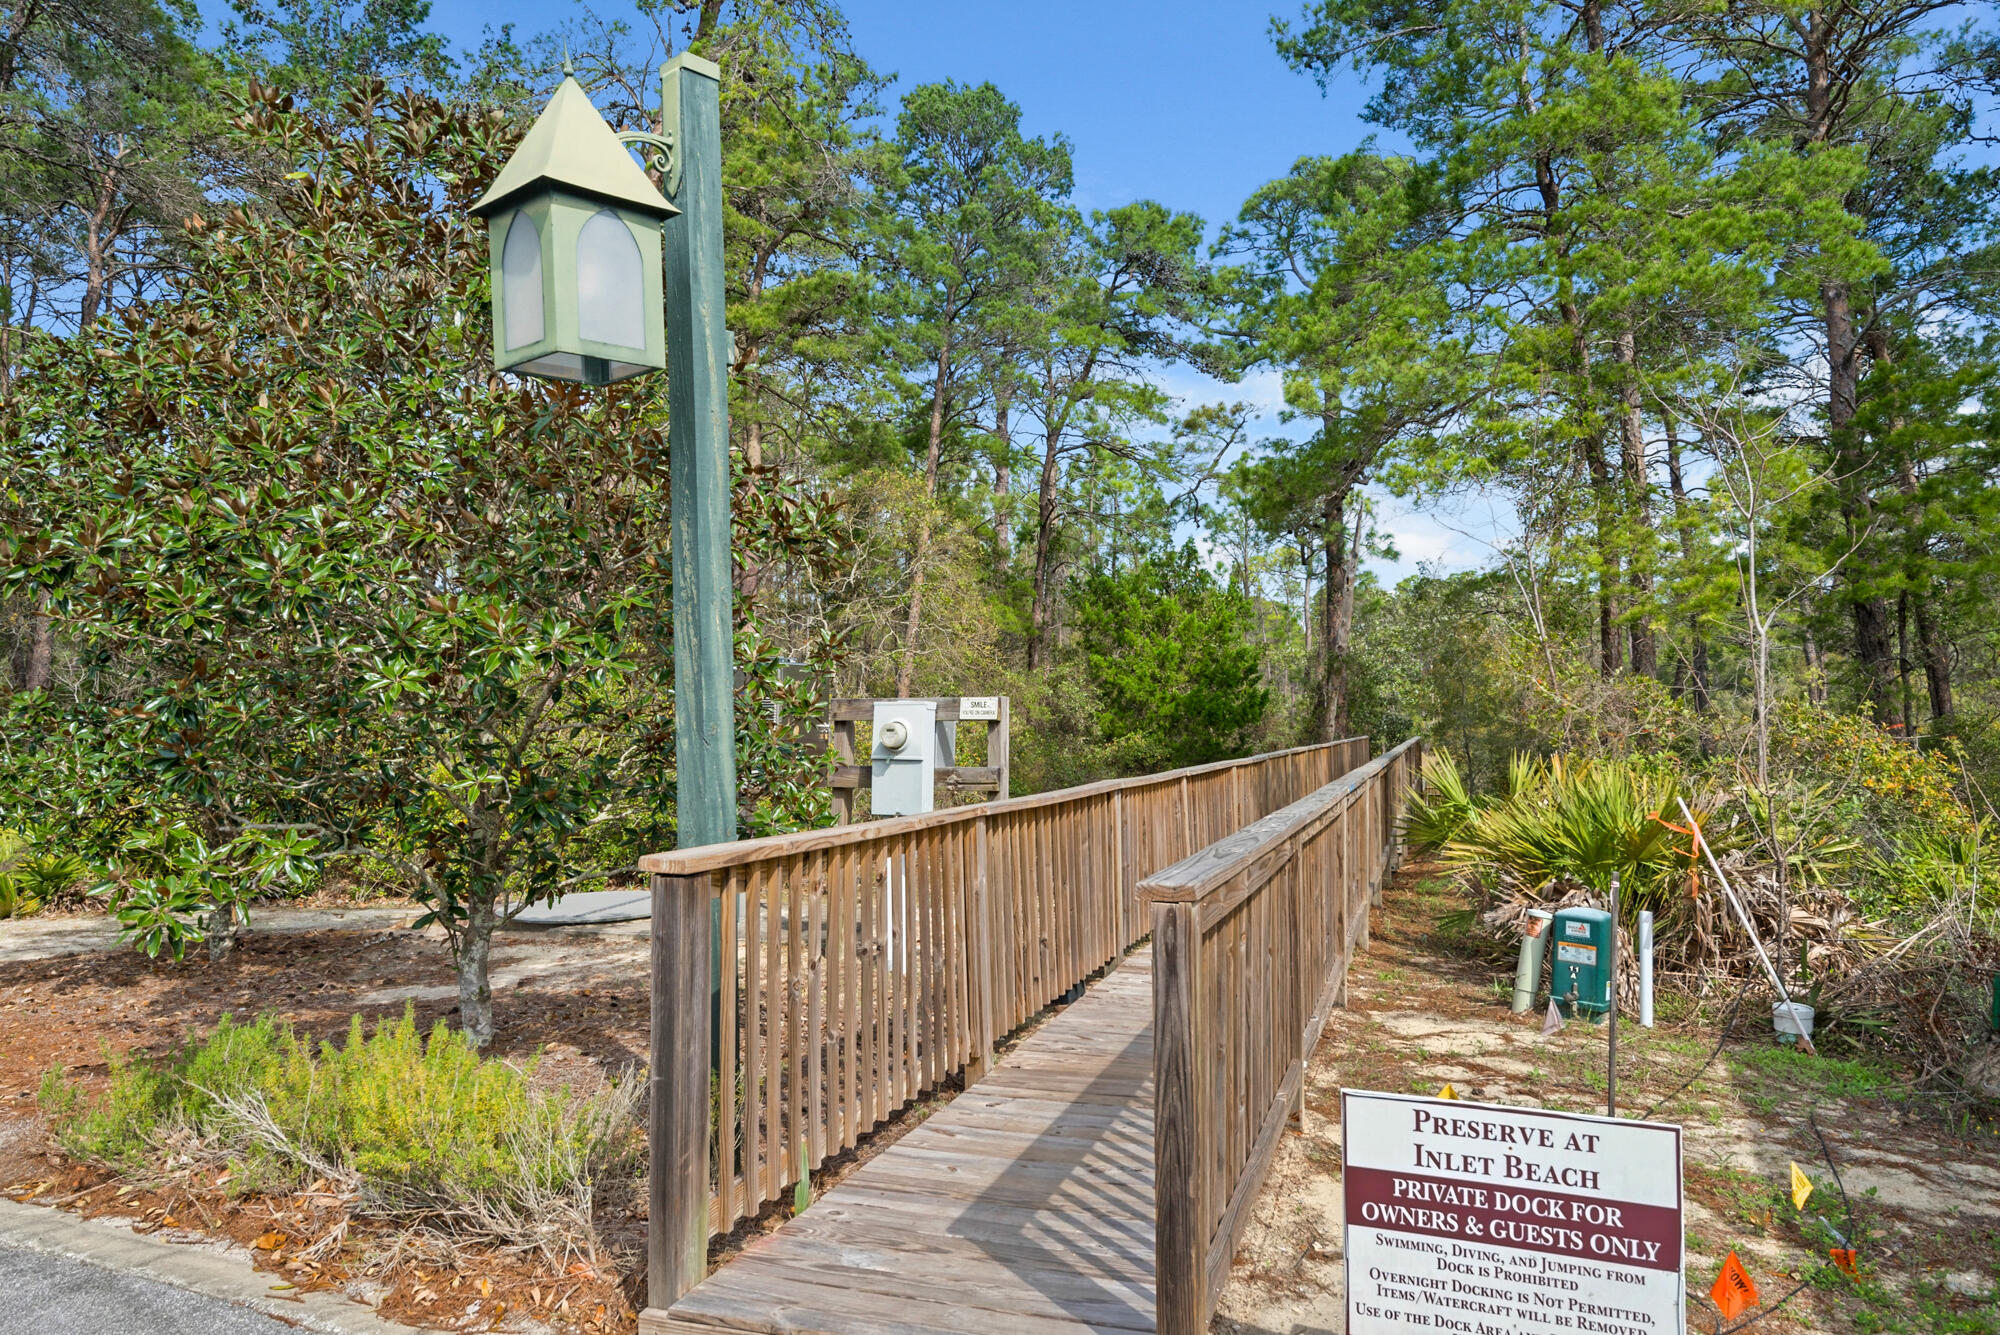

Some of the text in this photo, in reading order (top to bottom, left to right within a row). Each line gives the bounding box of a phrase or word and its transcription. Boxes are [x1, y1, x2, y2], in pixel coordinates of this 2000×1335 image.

[1412, 1108, 1600, 1153] PRESERVE AT
[1413, 1143, 1600, 1190] INLET BEACH
[1392, 1178, 1624, 1228] PRIVATE DOCK FOR
[1361, 1201, 1662, 1262] OWNERS & GUESTS ONLY
[1375, 1233, 1646, 1286] SWIMMING, DIVING, AND JUMPING FROM
[1436, 1257, 1579, 1291] DOCK IS PROHIBITED
[1355, 1302, 1381, 1318] USE
[1384, 1309, 1401, 1321] OF
[1403, 1312, 1431, 1326] THE
[1434, 1314, 1472, 1333] DOCK
[1369, 1267, 1656, 1327] OVERNIGHT DOCKING IS NOT PERMITTED,
[1376, 1283, 1513, 1317] ITEMS/WATERCRAFT
[1517, 1308, 1551, 1324] WILL
[1555, 1314, 1573, 1328] BE
